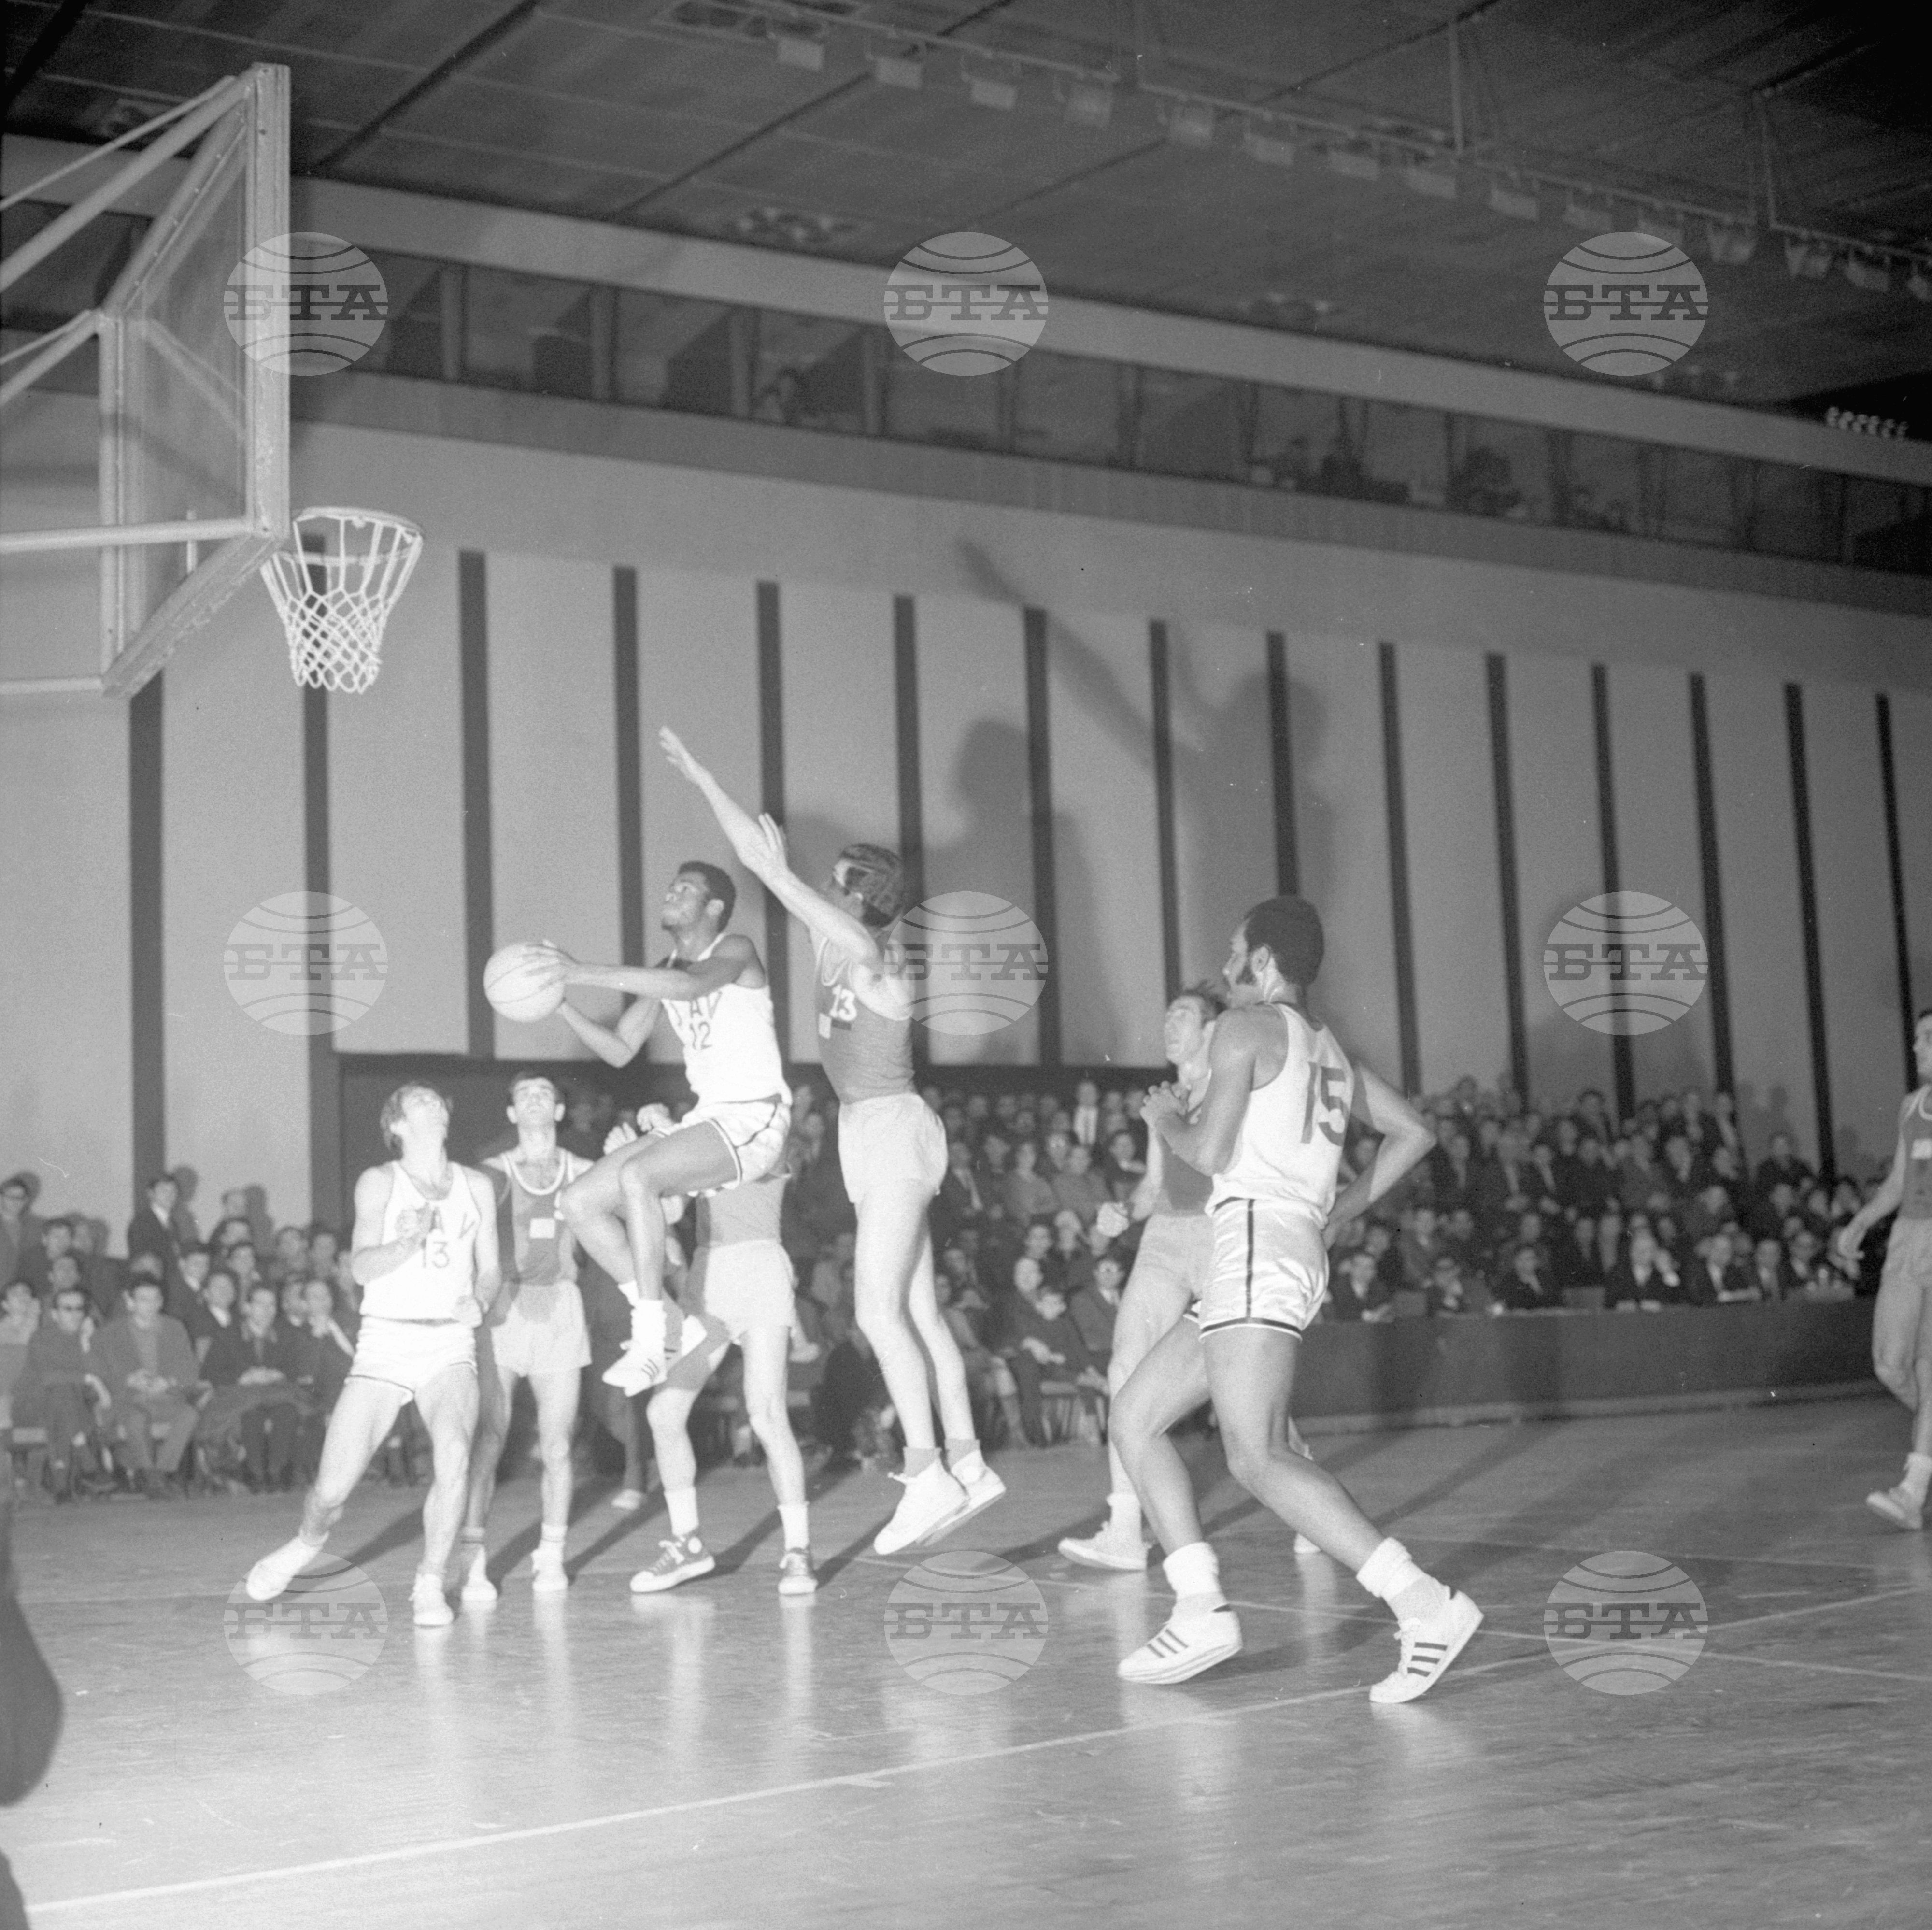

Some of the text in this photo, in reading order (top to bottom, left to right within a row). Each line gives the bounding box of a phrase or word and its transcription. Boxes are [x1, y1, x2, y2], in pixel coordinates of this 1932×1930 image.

[829, 984, 857, 1022] 13
[689, 1021, 713, 1050] 12
[1300, 1061, 1351, 1147] 15
[421, 1240, 450, 1269] 13
